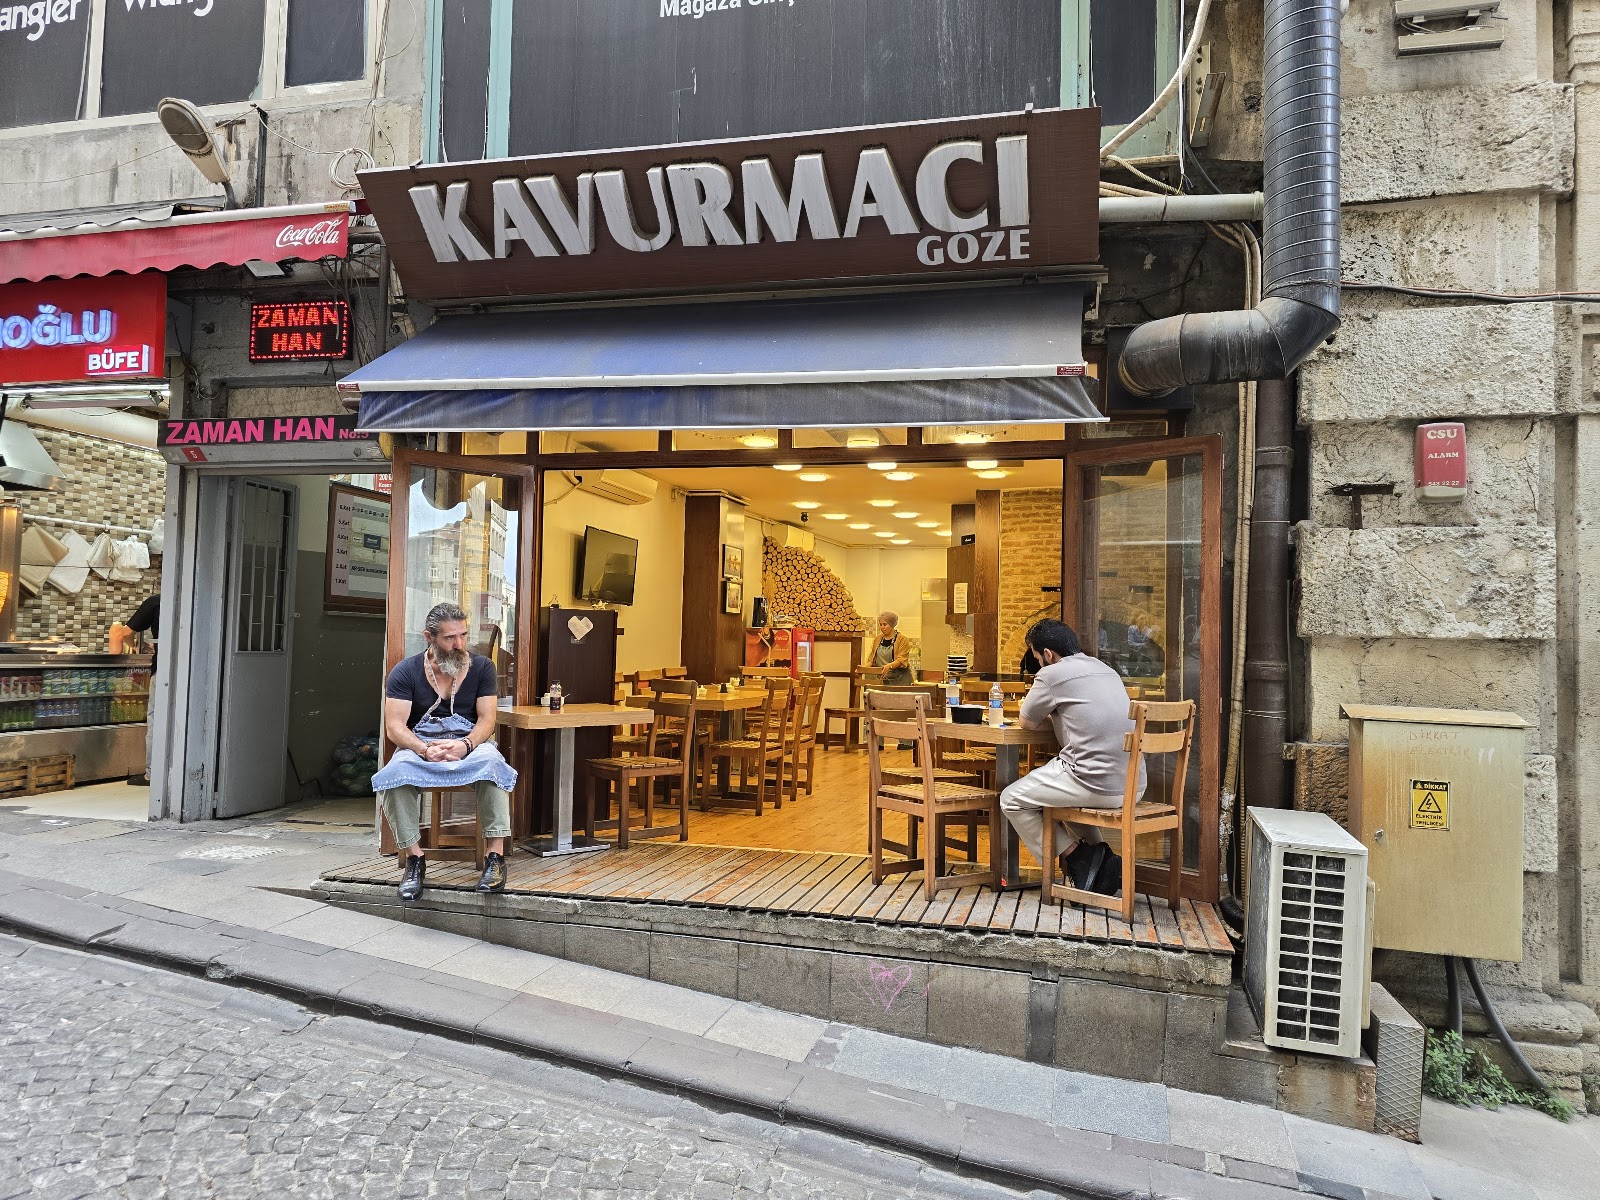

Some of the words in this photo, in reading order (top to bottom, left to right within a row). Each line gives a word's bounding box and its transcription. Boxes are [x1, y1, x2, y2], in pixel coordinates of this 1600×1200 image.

[408, 134, 1032, 265] KAVURMACI
[916, 229, 1031, 267] GOZE
[0, 304, 113, 349] OĞLU
[257, 307, 339, 328] ZAMAN
[271, 332, 322, 352] HAN
[88, 348, 140, 371] BÜFE
[166, 419, 265, 444] ZAMAN
[273, 417, 335, 441] HAN
[1426, 428, 1458, 440] CSU
[1427, 451, 1460, 459] ALARM
[1423, 782, 1447, 791] DİKKAT
